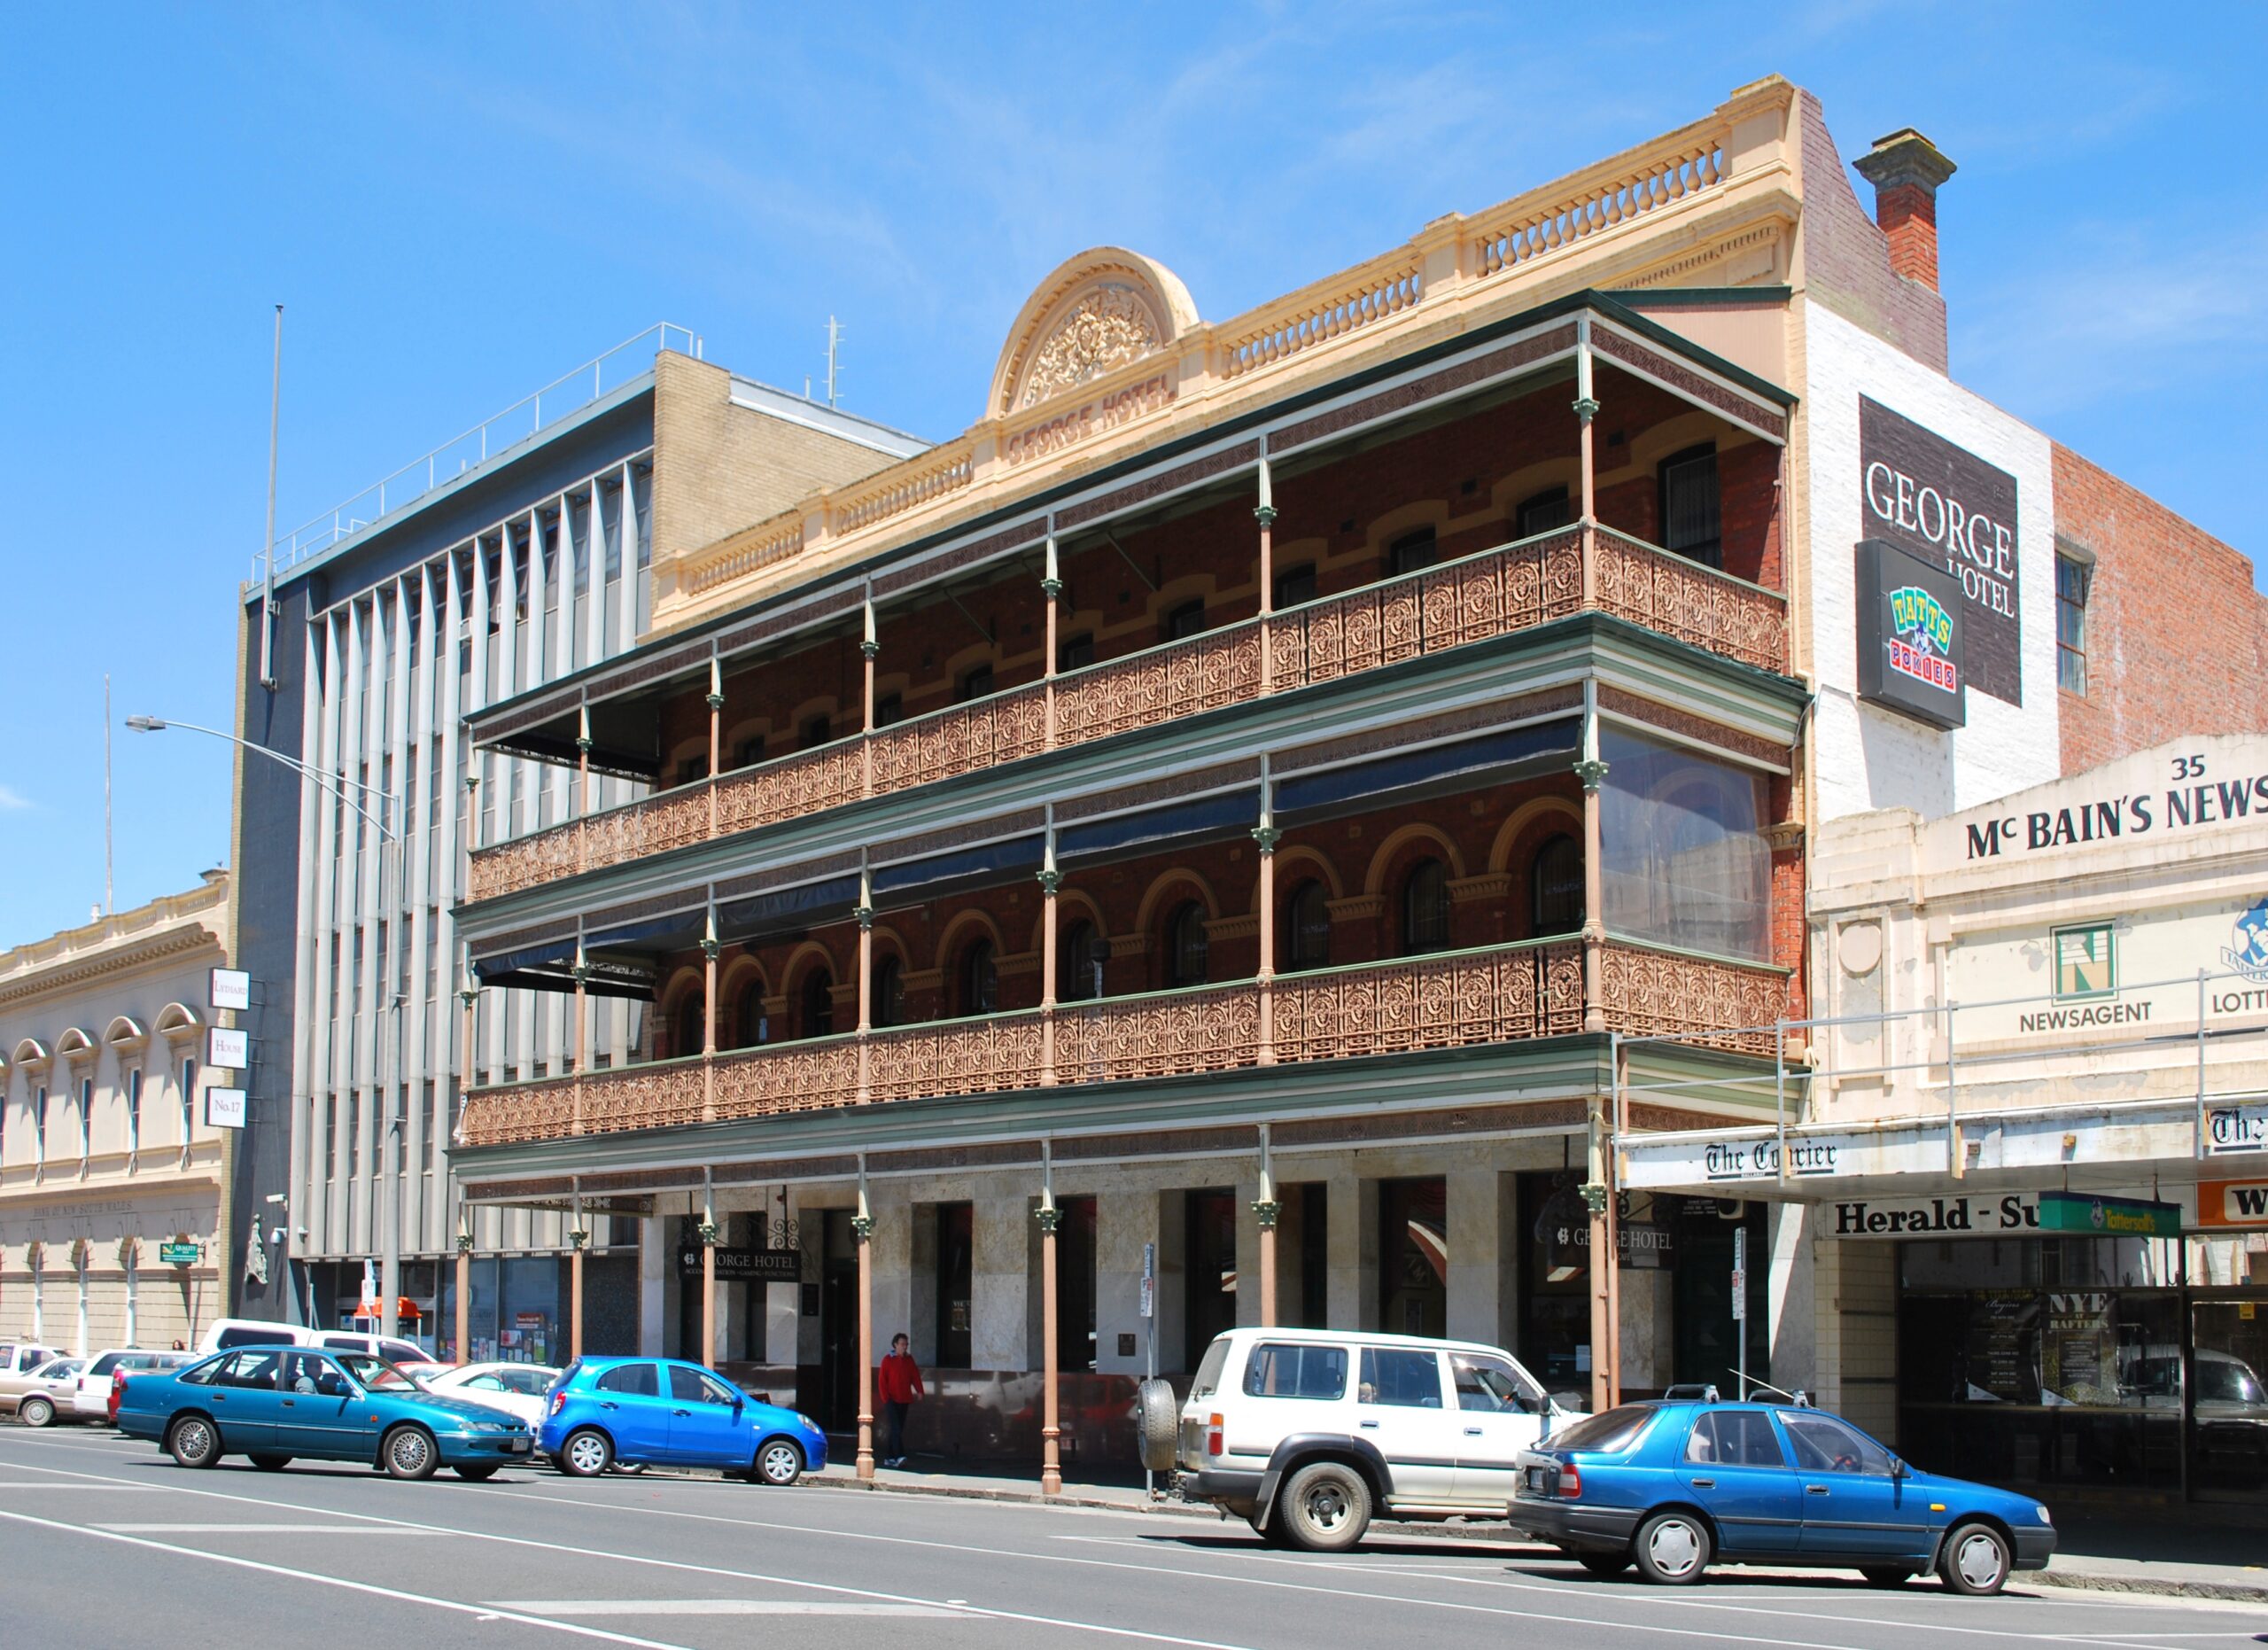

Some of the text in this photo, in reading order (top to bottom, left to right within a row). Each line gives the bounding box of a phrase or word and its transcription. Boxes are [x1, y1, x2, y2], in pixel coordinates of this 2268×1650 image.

[1009, 374, 1178, 465] GEORGE HOTEL
[1866, 461, 2014, 580] GEORGE
[1894, 595, 1950, 644] TATTS
[1893, 647, 1953, 684] POKIES
[2171, 754, 2206, 781] 35
[2020, 1001, 2153, 1032] NEWSAGENT
[2213, 990, 2268, 1013] LOTT
[2210, 1109, 2265, 1144] The
[1705, 1140, 1837, 1173] The Corier
[1835, 1198, 1971, 1234] Herald
[2000, 1195, 2039, 1229] Su
[2106, 1209, 2155, 1233] Tattersall's
[1630, 1231, 1674, 1250] HOTEL
[700, 1253, 796, 1269] ORGE HOTEL
[2049, 1293, 2108, 1313] NYE
[2049, 1319, 2109, 1329] RAFTERS
